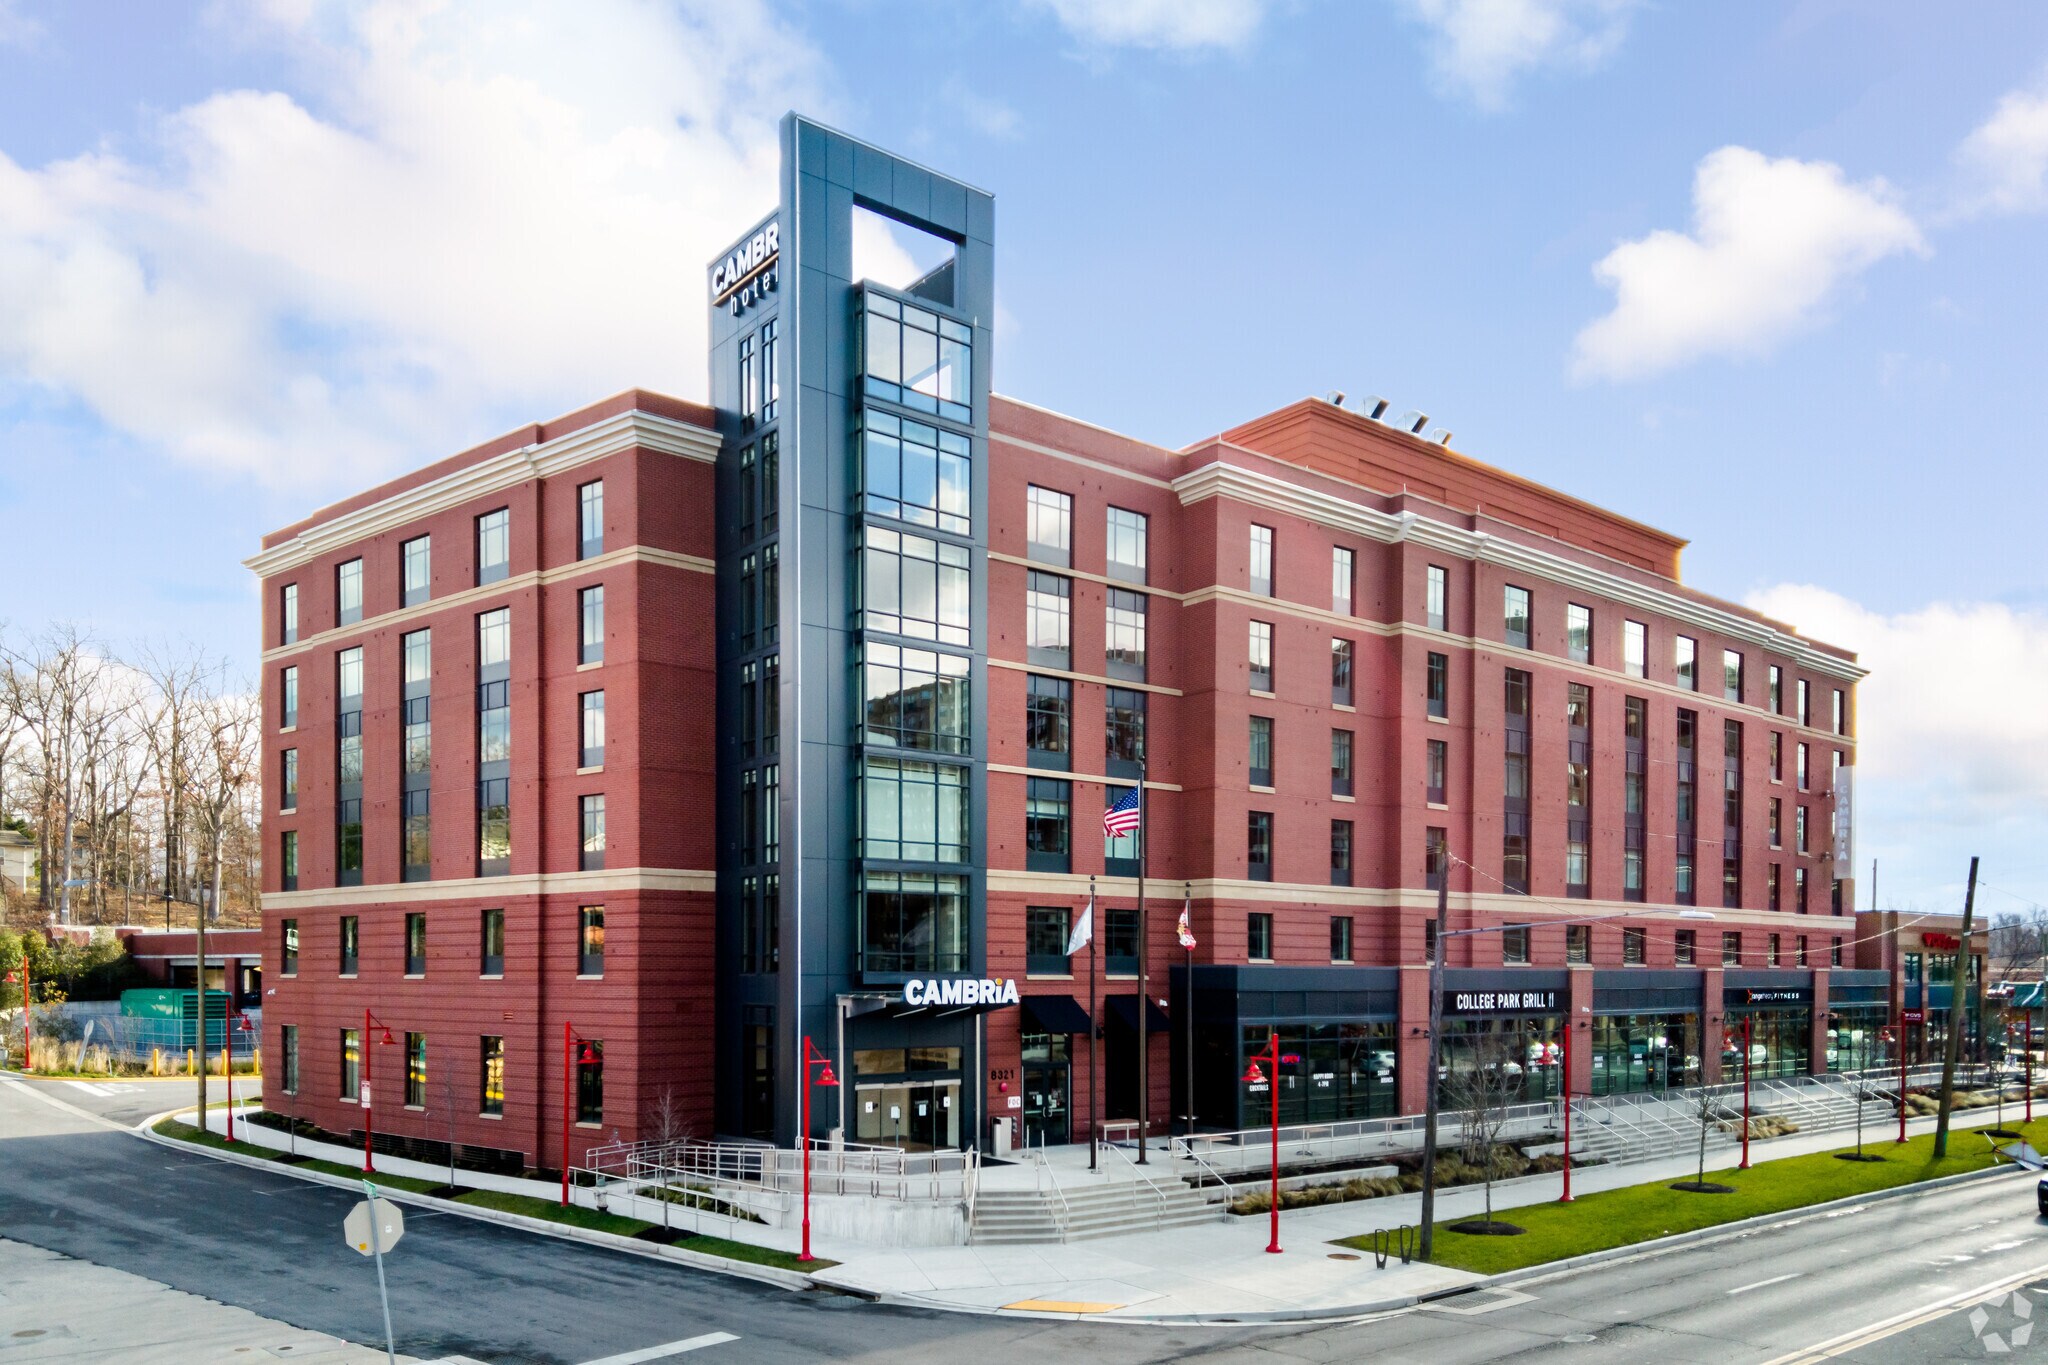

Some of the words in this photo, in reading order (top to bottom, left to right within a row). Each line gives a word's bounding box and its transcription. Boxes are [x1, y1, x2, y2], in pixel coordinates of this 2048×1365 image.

[730, 260, 779, 316] hotel
[1457, 993, 1496, 1010] COLLEGE
[1498, 993, 1521, 1009] PARK
[1522, 992, 1546, 1008] GRILL
[1774, 992, 1800, 1000] FITNESS
[991, 1070, 1014, 1080] 8321
